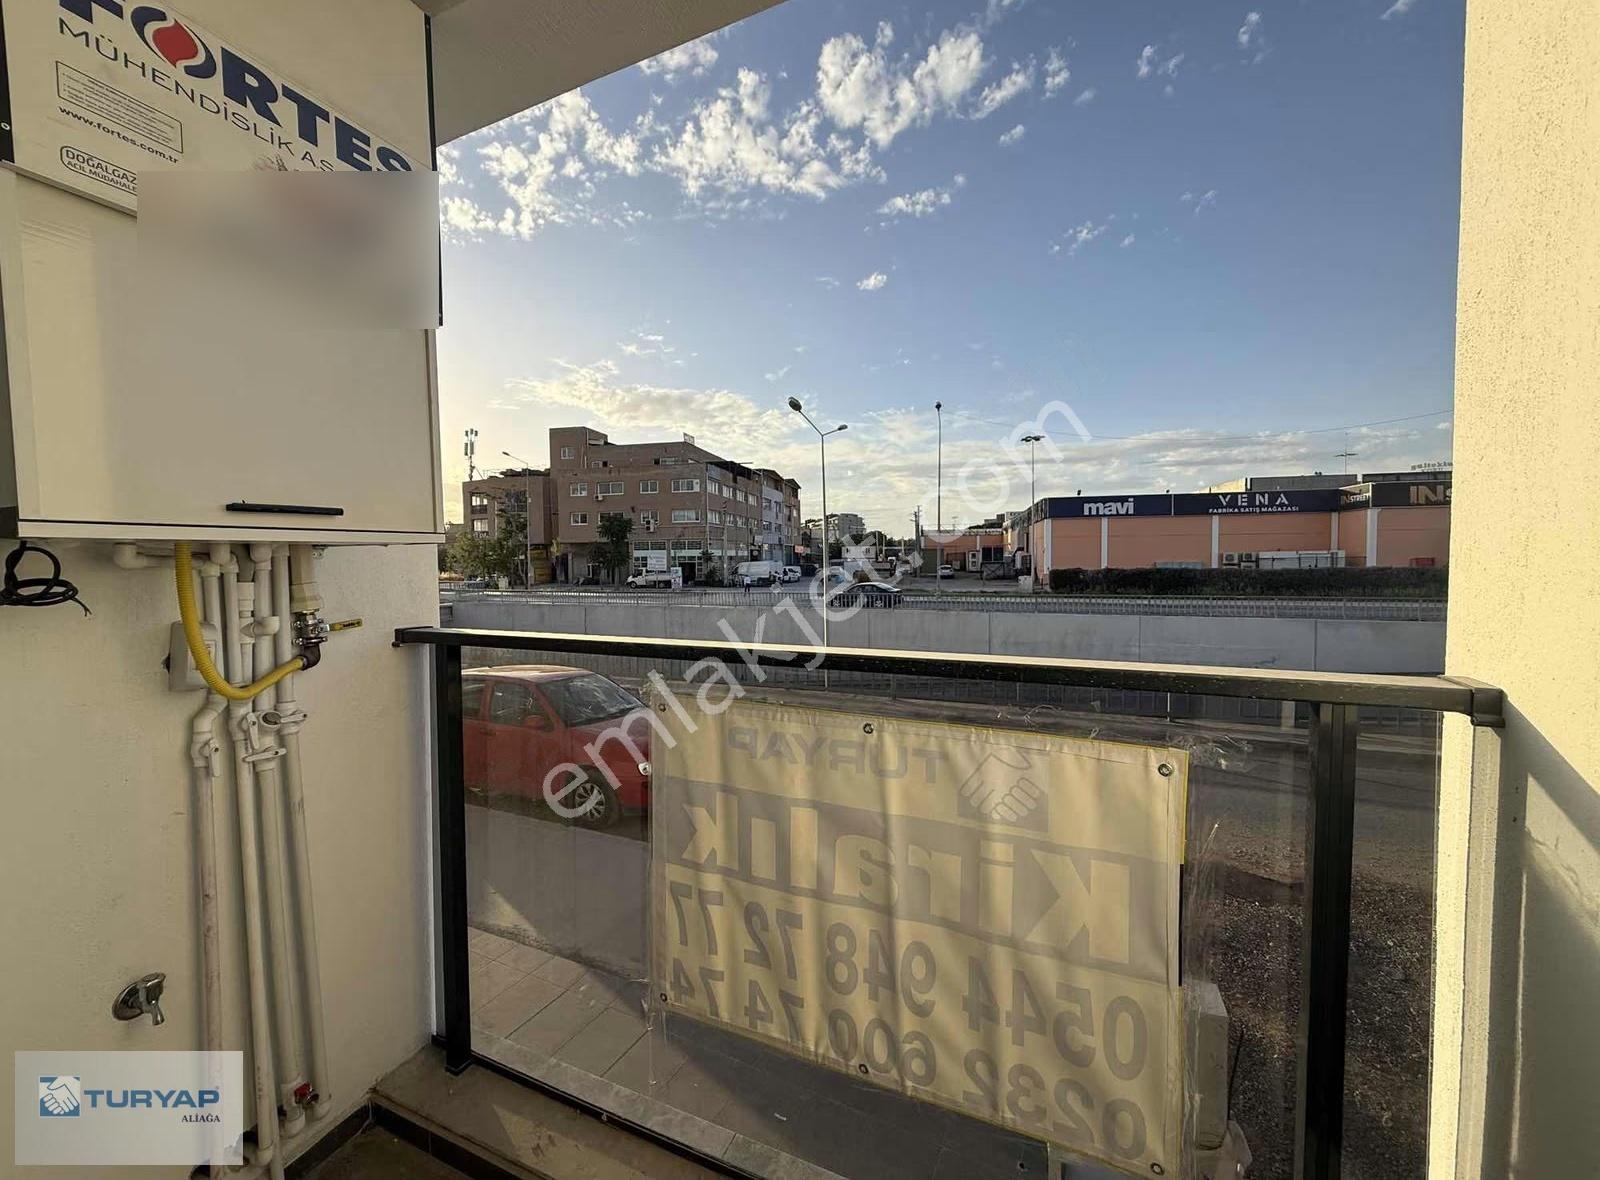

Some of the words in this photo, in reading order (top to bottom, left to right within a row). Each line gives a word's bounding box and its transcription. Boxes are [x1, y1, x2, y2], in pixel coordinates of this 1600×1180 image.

[58, 106, 179, 163] www.fortes.com.tr
[1083, 498, 1134, 515] mavi
[1218, 493, 1289, 506] VENA
